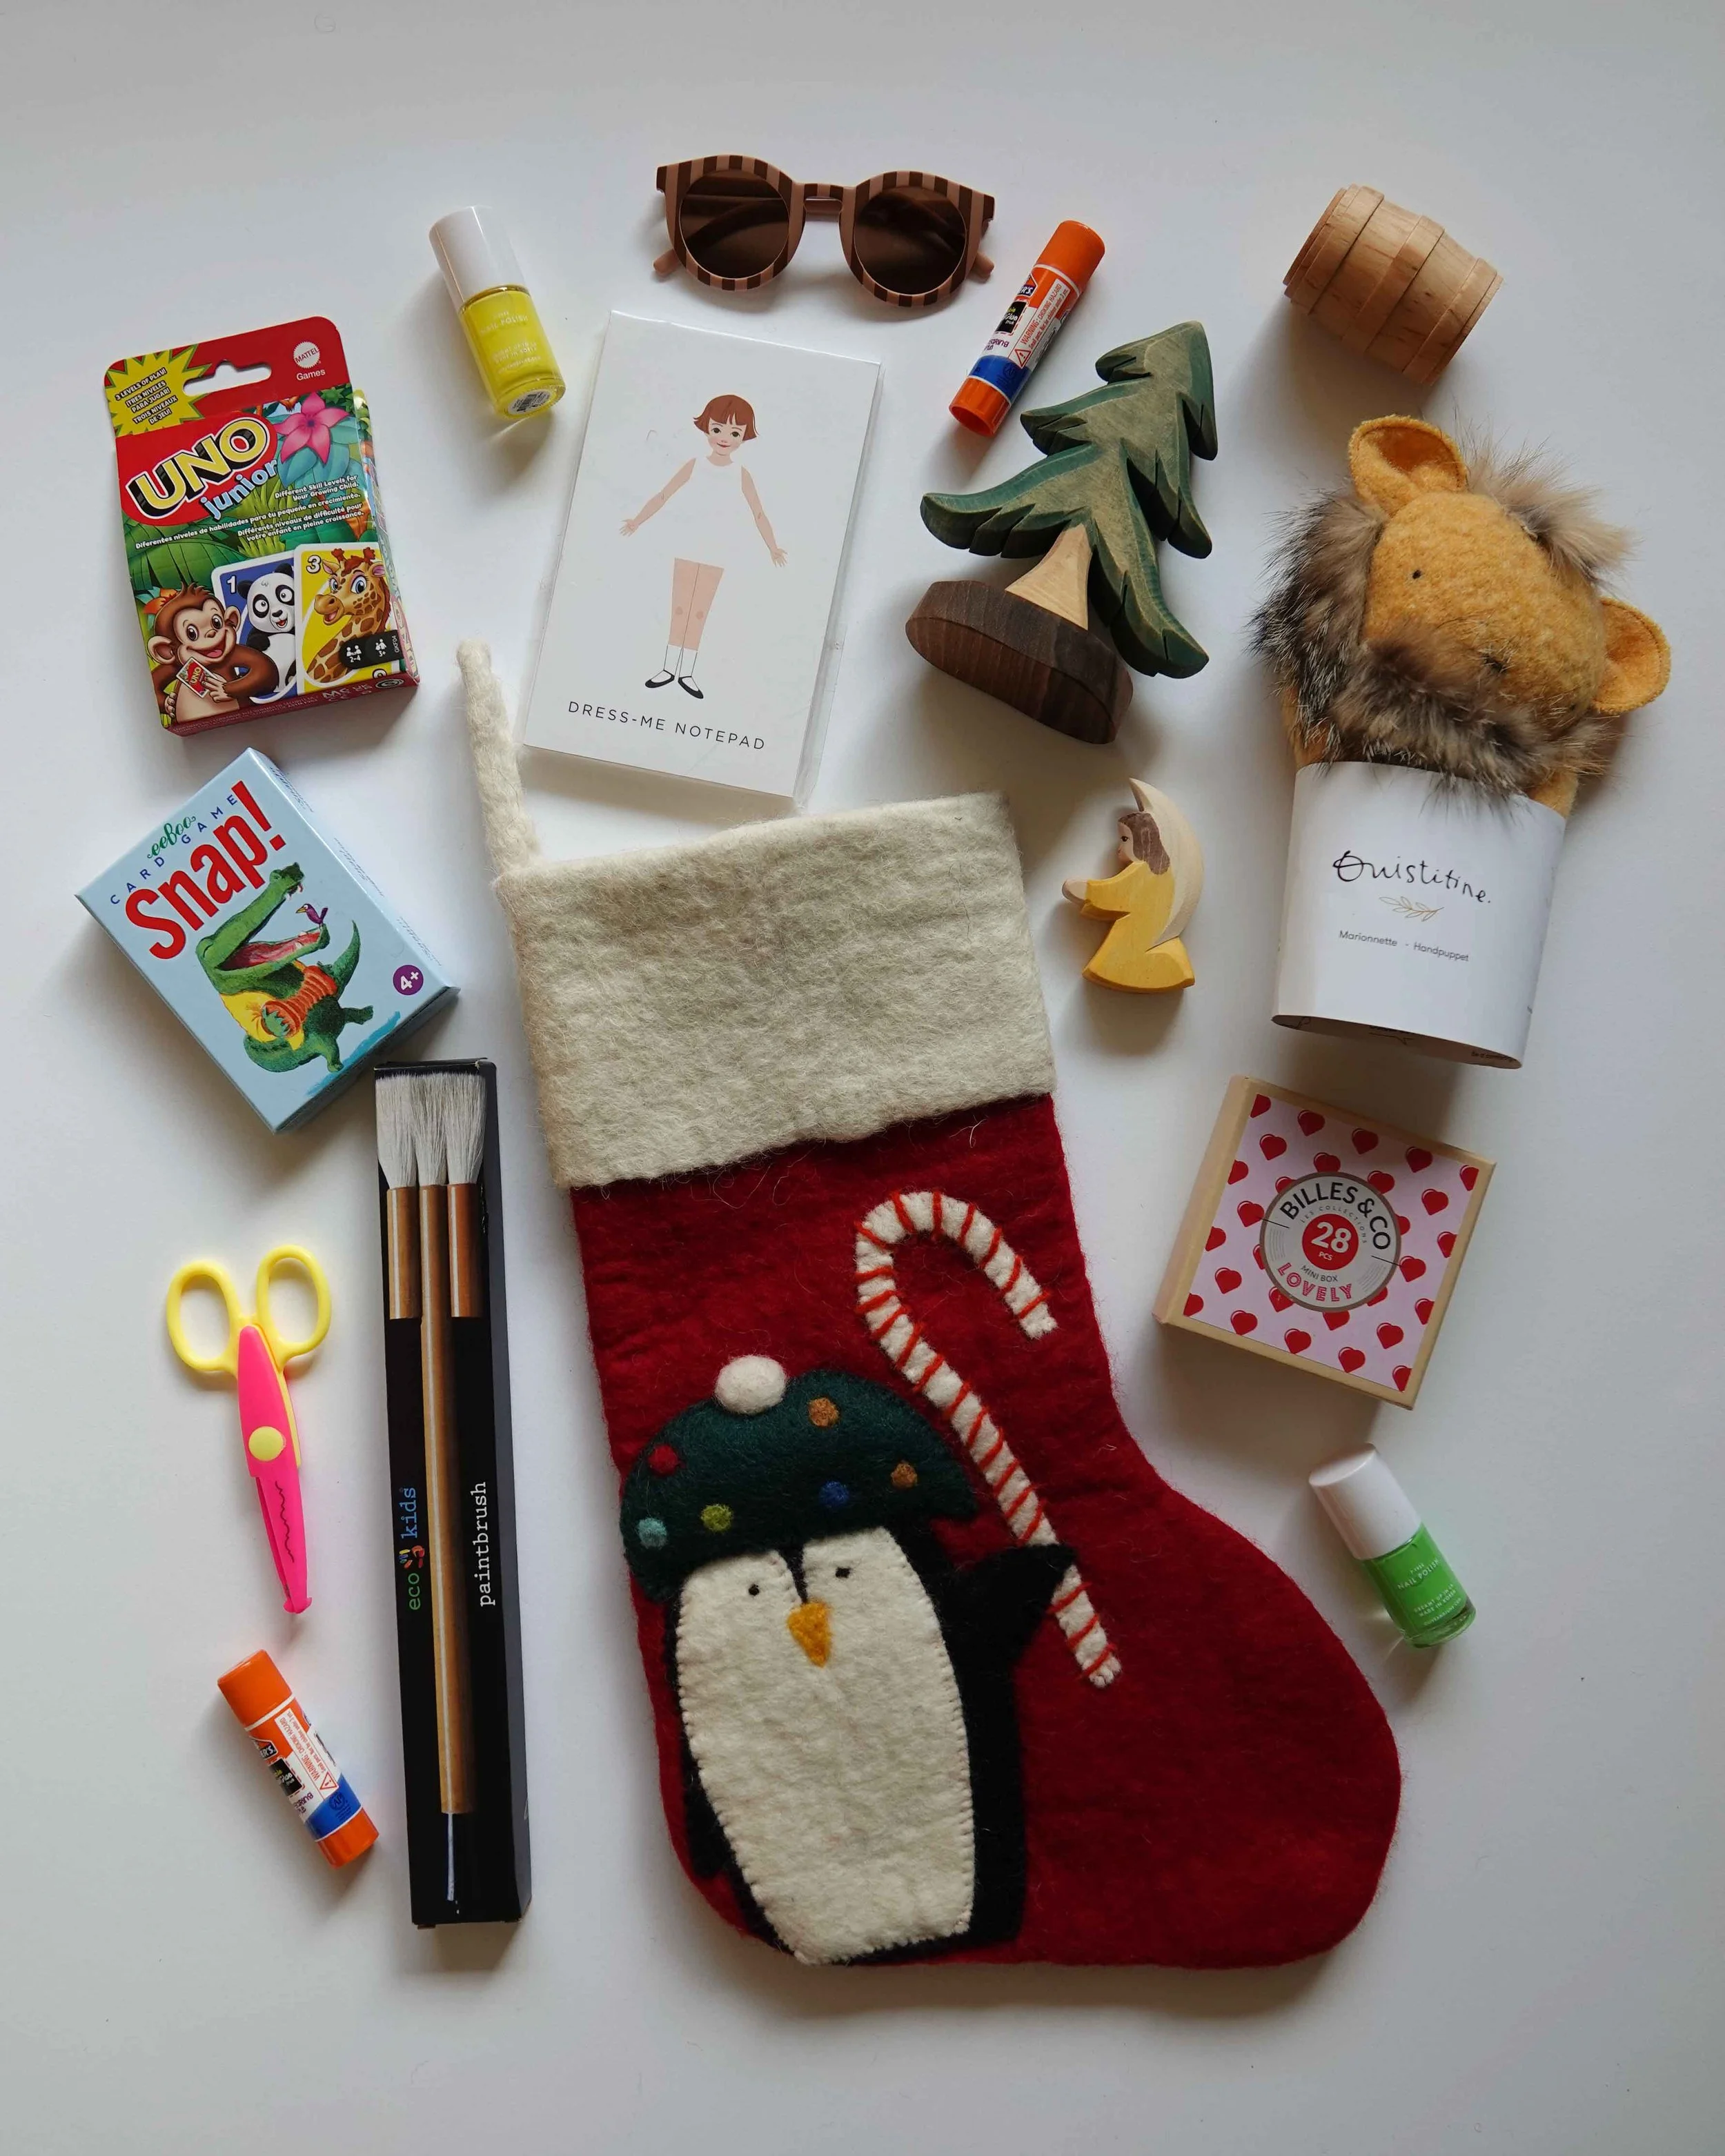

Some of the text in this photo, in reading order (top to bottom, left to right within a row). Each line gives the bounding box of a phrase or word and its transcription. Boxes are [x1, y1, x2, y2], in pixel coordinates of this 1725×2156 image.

[295, 347, 319, 363] MATTEL
[297, 369, 326, 381] Games
[120, 382, 141, 398] LEVELS
[141, 377, 150, 386] OF
[141, 380, 166, 397] NIVELES
[131, 401, 149, 413] PARA
[133, 395, 178, 424] TROIS NIVEAUX
[148, 415, 159, 425] DE
[127, 418, 270, 518] UNO
[201, 459, 277, 520] junior
[275, 475, 358, 499] Different Skill Levels for
[310, 485, 338, 497] Growing
[339, 482, 359, 491] Child.
[136, 535, 173, 550] Diferentes
[173, 529, 199, 541] niveles
[208, 518, 249, 533] habilidades
[250, 514, 267, 524] para
[277, 504, 307, 518] pequeño
[317, 493, 361, 506] crecimiento.
[237, 522, 274, 537] Différents
[275, 517, 302, 529] niveaux
[313, 506, 346, 520] difficulté
[346, 503, 363, 513] pour
[246, 532, 267, 542] votre
[267, 526, 292, 537] enfant
[302, 520, 324, 531] pleine
[324, 511, 364, 524] croissance.
[306, 555, 322, 573] 3
[227, 577, 237, 594] 1
[349, 655, 361, 663] 2-4
[189, 666, 201, 686] UNO
[568, 701, 765, 751] DRESS-ME NOTEPAD
[110, 794, 238, 906] CARD GAME
[125, 780, 286, 960] Snap!
[1339, 929, 1398, 947] Marionnette
[1413, 942, 1469, 962] Handpuppet
[400, 971, 420, 991] 4+
[1311, 1222, 1352, 1254] 28
[1318, 1252, 1334, 1261] PCS
[1278, 1262, 1352, 1303] LOVELY
[1301, 1265, 1339, 1283] MINI BOX
[400, 1487, 422, 1610] eco kids
[470, 1481, 495, 1608] paintbrush
